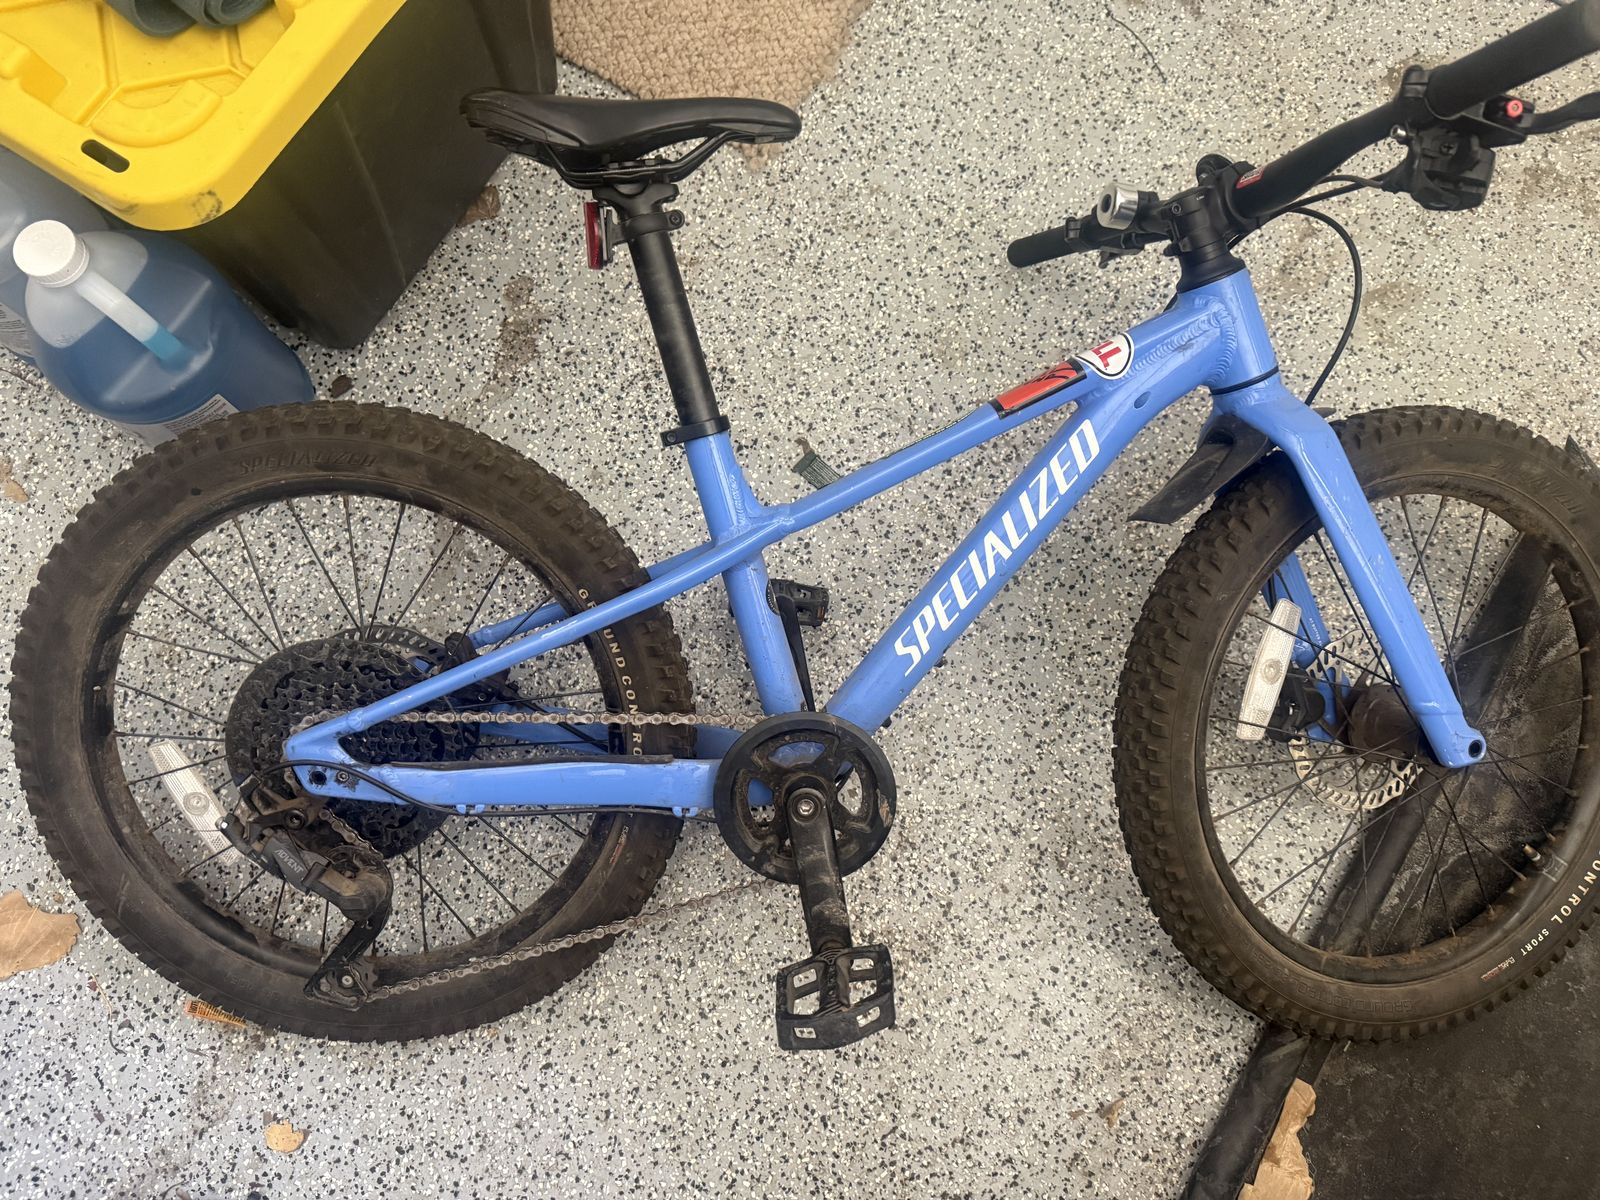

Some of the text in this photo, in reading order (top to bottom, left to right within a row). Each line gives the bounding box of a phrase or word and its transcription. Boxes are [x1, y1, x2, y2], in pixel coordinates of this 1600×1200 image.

[894, 418, 1101, 677] SPECIALIZED
[578, 588, 643, 756] GRUND CONRO
[275, 848, 304, 874] ADVENT
[1520, 850, 1600, 957] ONTROL SPORT
